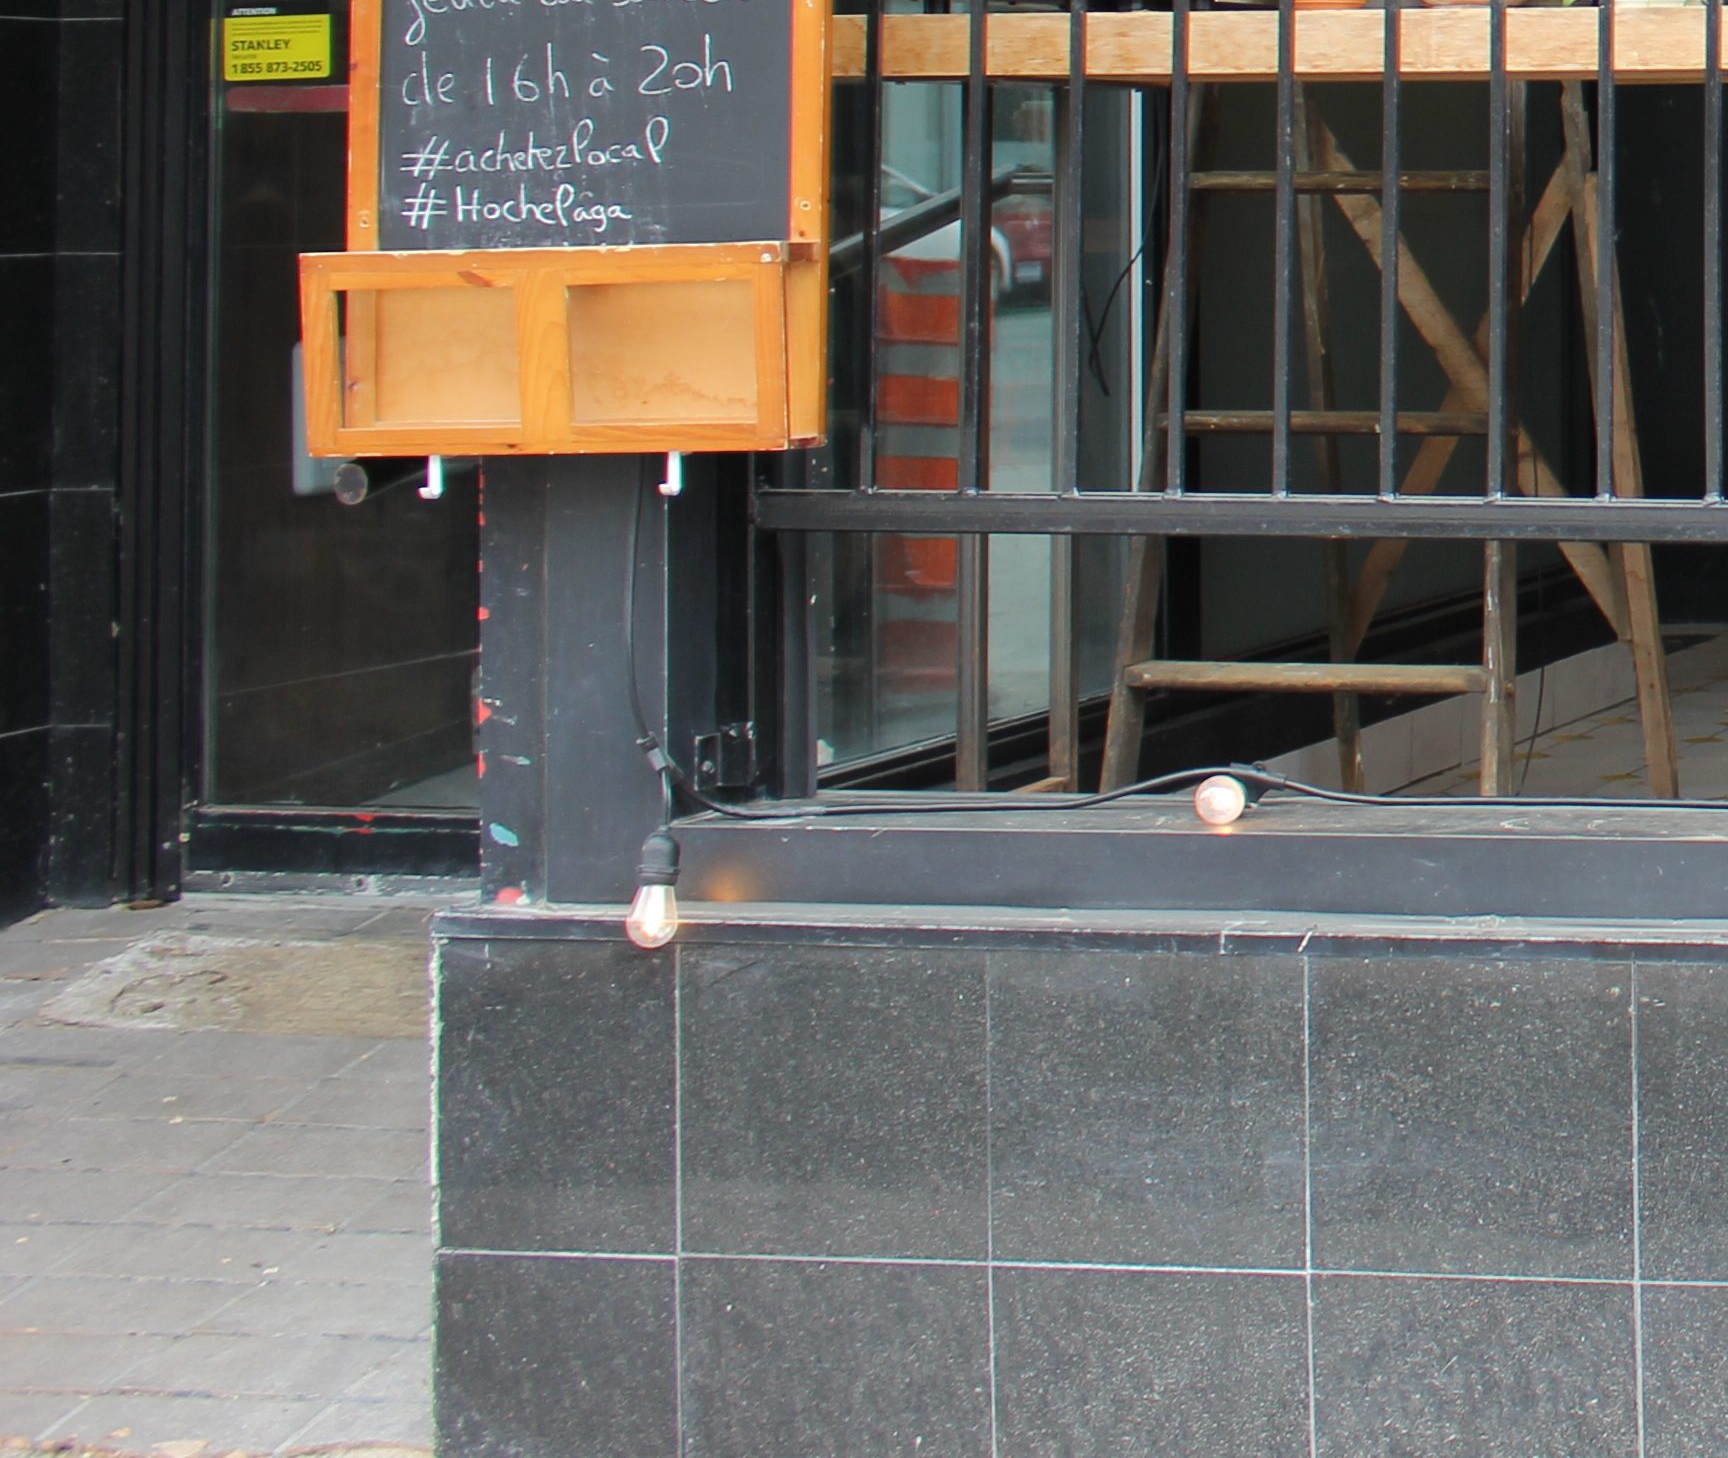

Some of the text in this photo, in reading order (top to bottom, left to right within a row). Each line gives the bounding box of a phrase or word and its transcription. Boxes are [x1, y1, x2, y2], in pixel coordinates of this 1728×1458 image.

[231, 39, 292, 52] STANLEY
[402, 51, 456, 106] de
[485, 43, 571, 105] 16h
[589, 52, 615, 98] à
